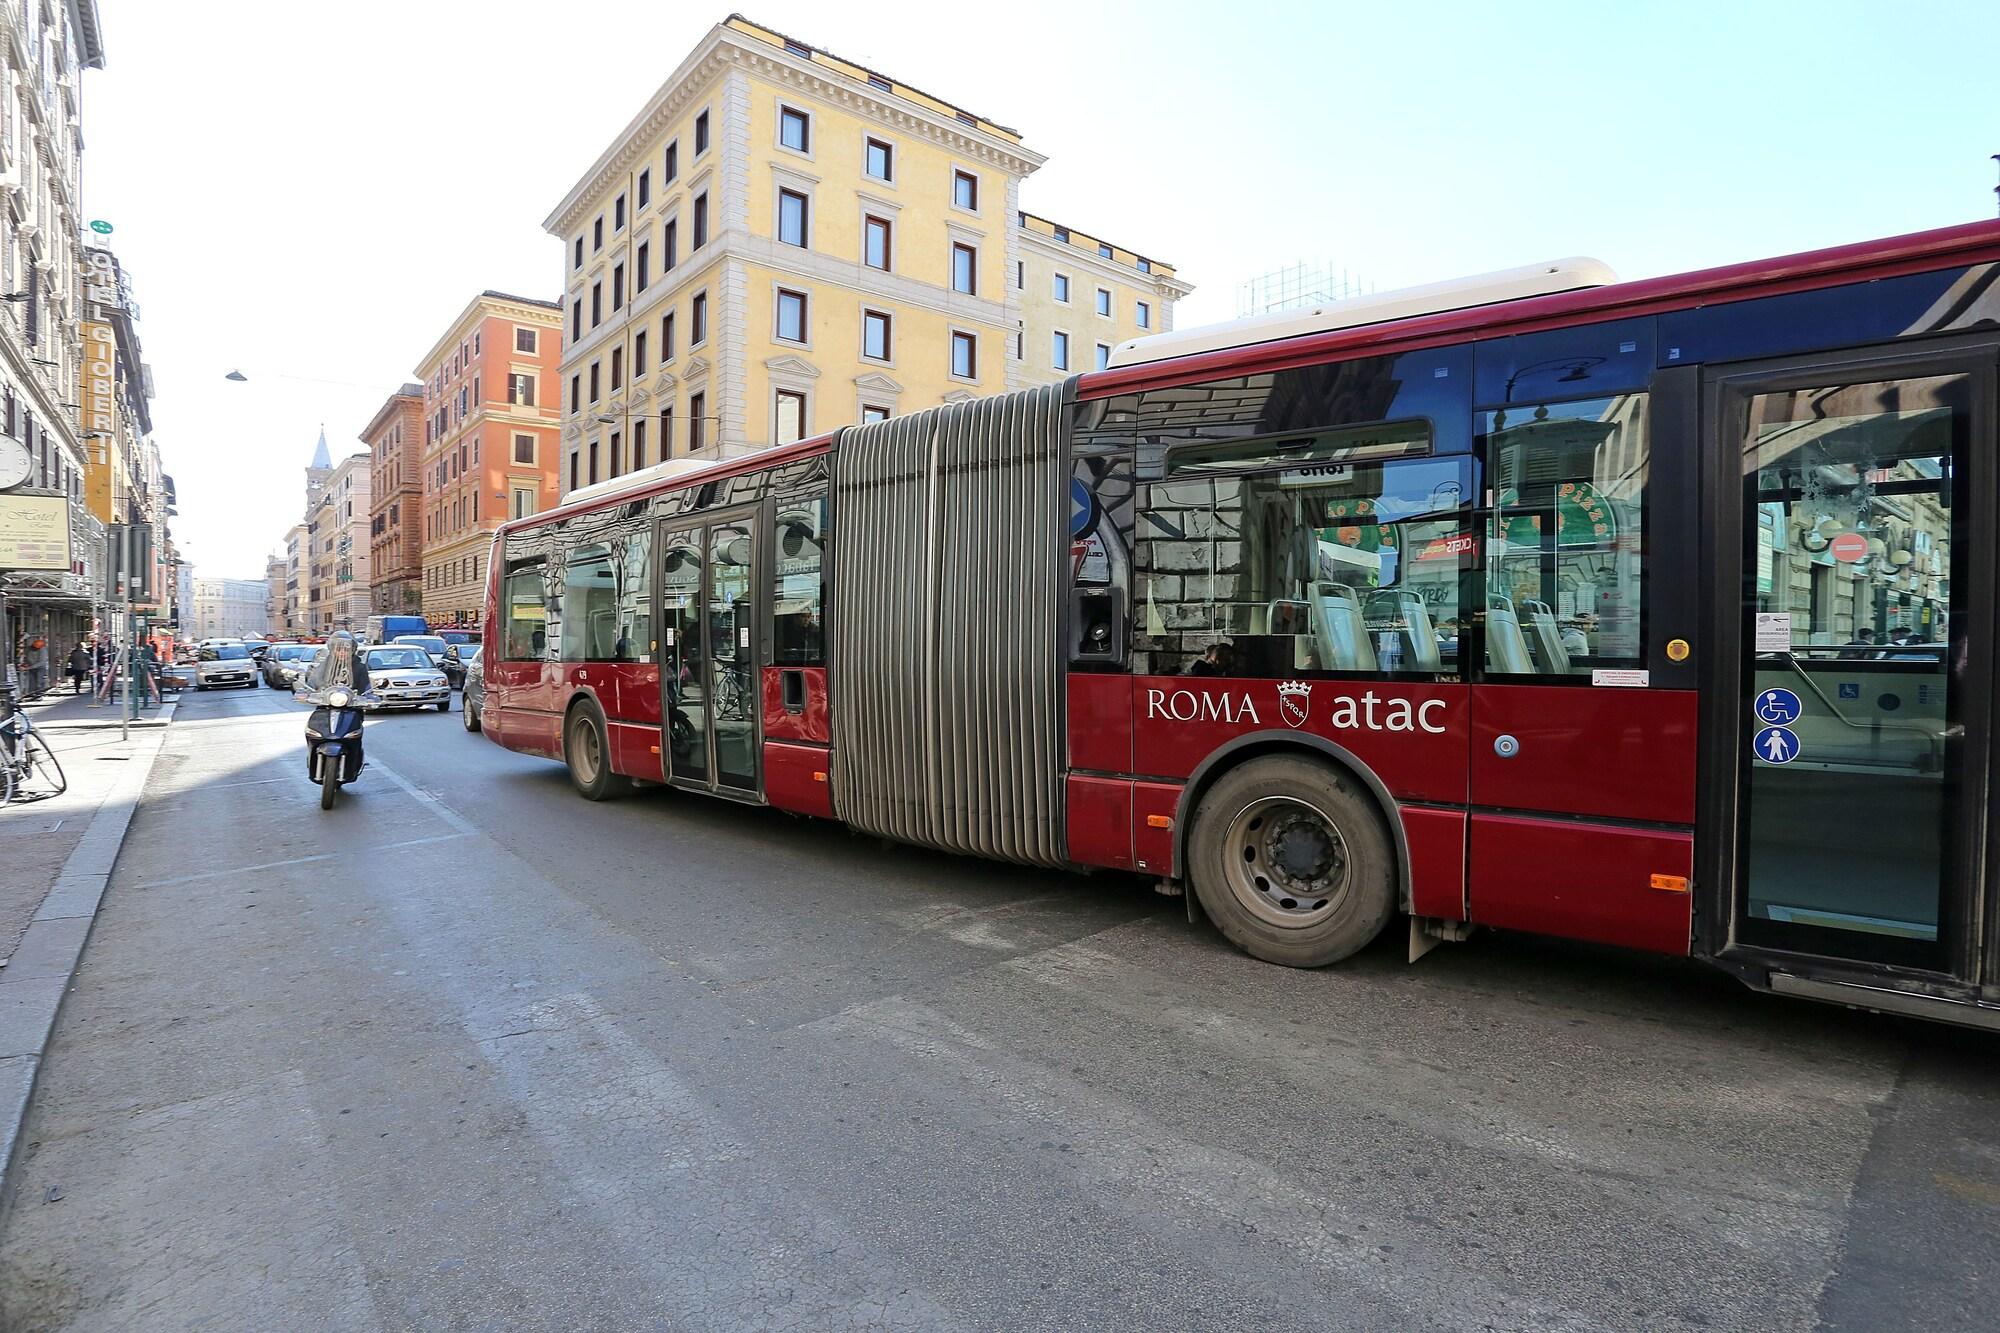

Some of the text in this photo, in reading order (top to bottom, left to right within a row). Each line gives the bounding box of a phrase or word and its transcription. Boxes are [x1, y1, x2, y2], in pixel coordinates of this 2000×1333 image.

[91, 234, 114, 465] HOTEL GIOBERTI
[1558, 483, 1608, 537] Pizza
[1147, 689, 1261, 724] ROMA
[1285, 700, 1305, 718] SPQR
[1332, 690, 1446, 733] atac
